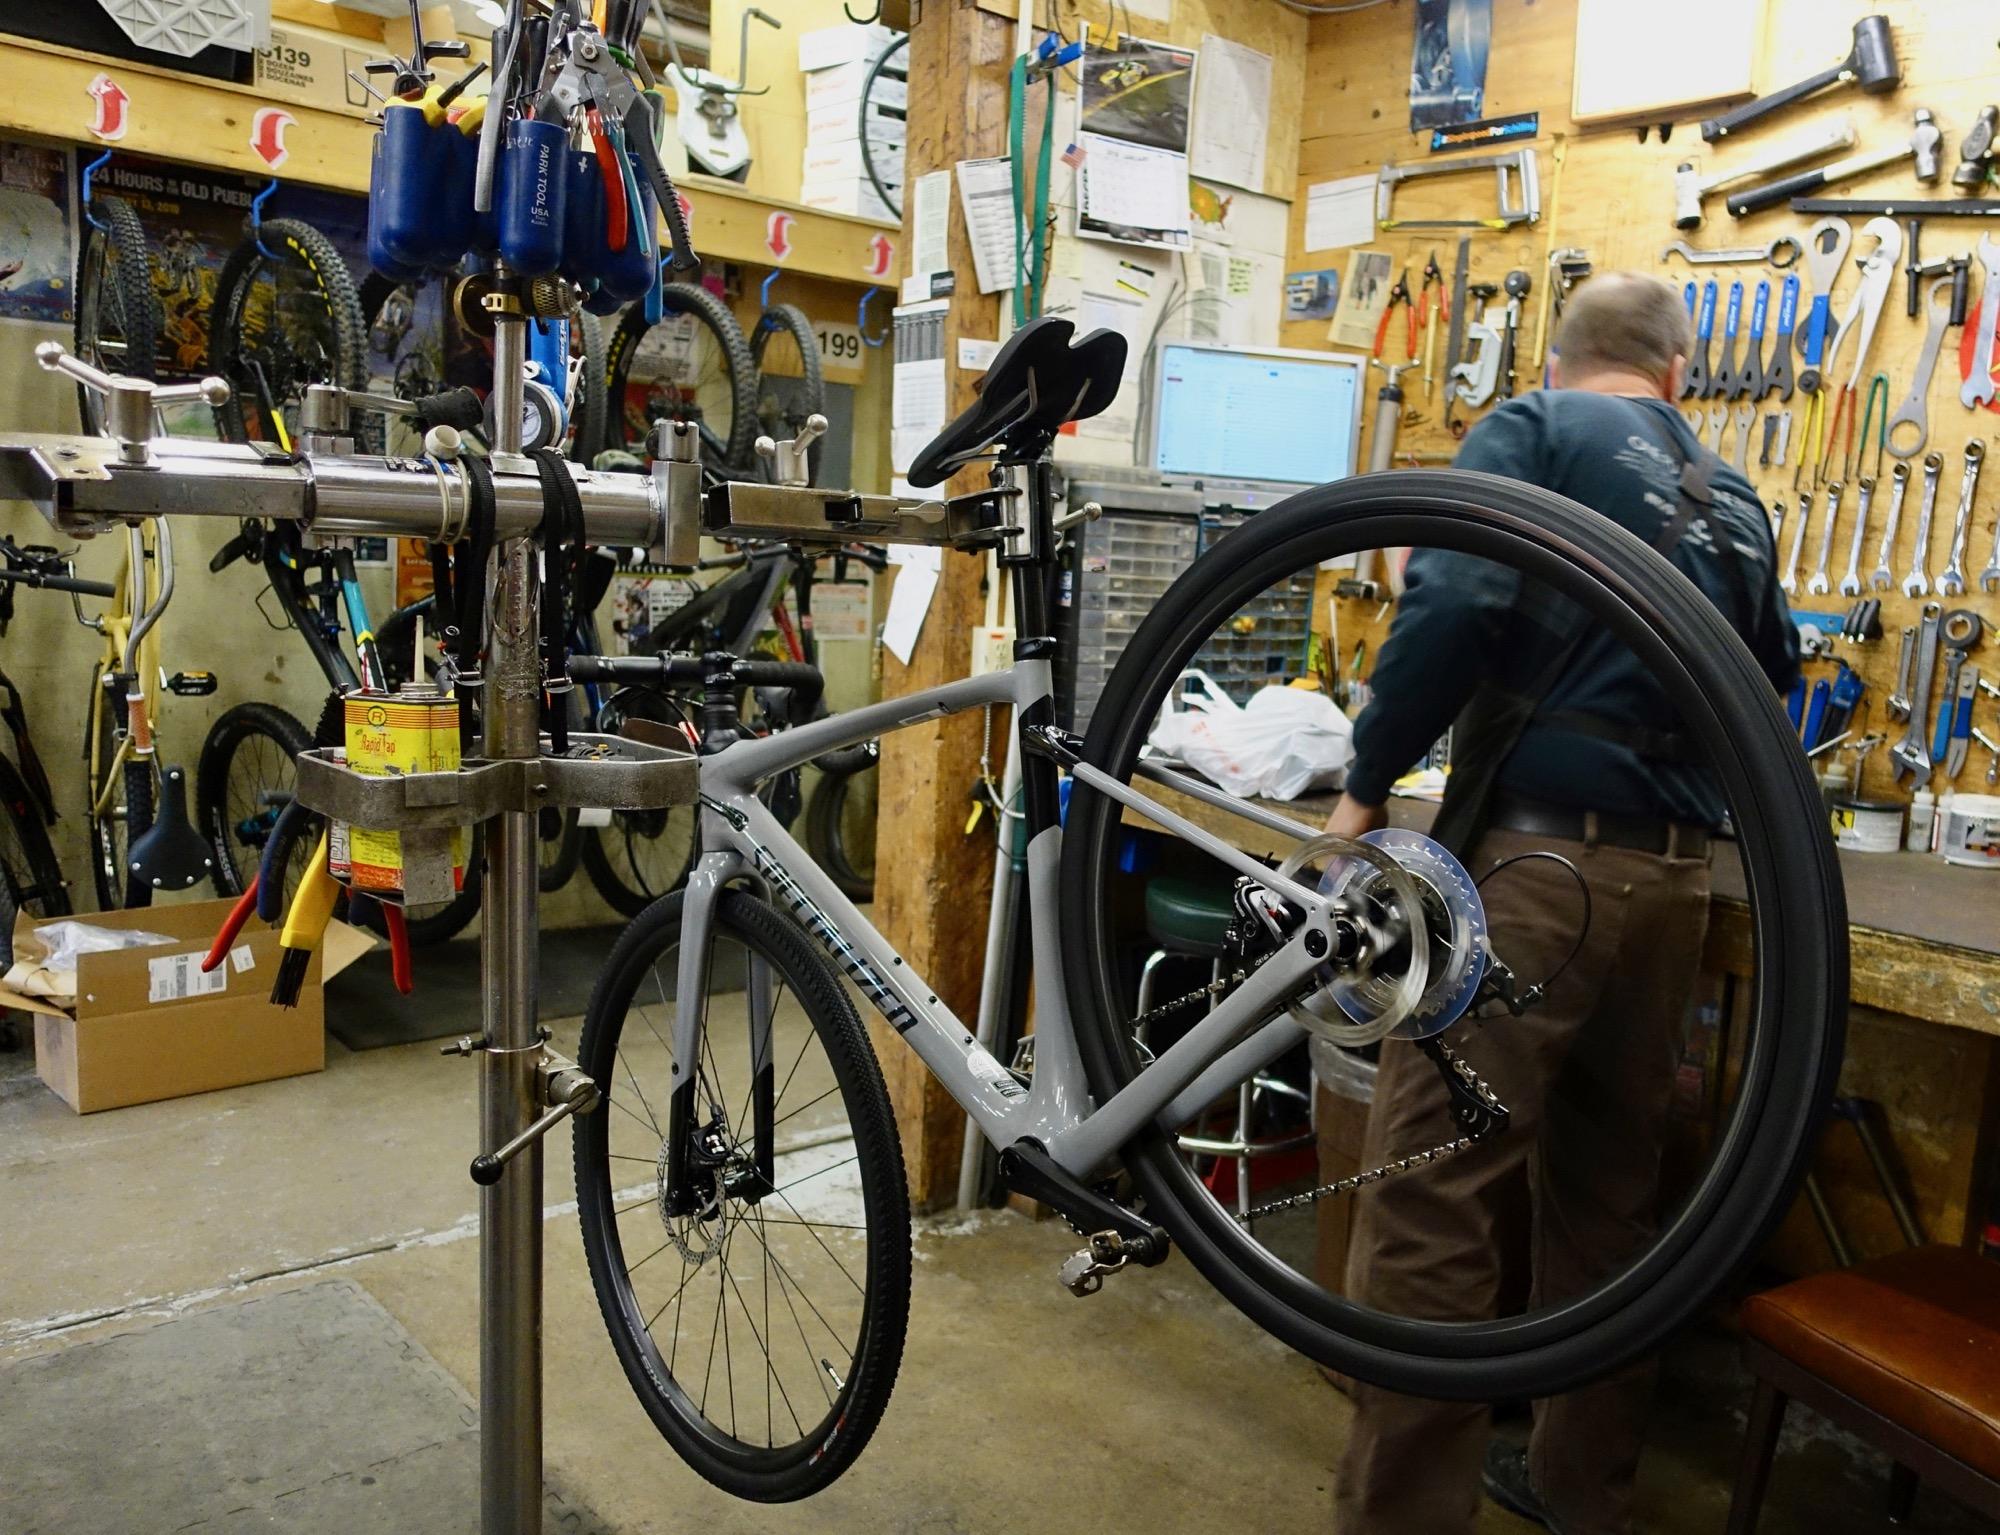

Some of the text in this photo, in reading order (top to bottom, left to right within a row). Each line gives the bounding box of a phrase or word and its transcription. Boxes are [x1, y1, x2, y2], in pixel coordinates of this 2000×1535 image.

[538, 144, 550, 177] PARK
[114, 168, 164, 193] HOURS
[536, 178, 548, 207] TOOL
[531, 206, 549, 217] USA
[818, 330, 860, 359] 199
[371, 711, 383, 722] R
[361, 732, 396, 756] Rapid Tap
[754, 845, 919, 1036] SPECIALIZED
